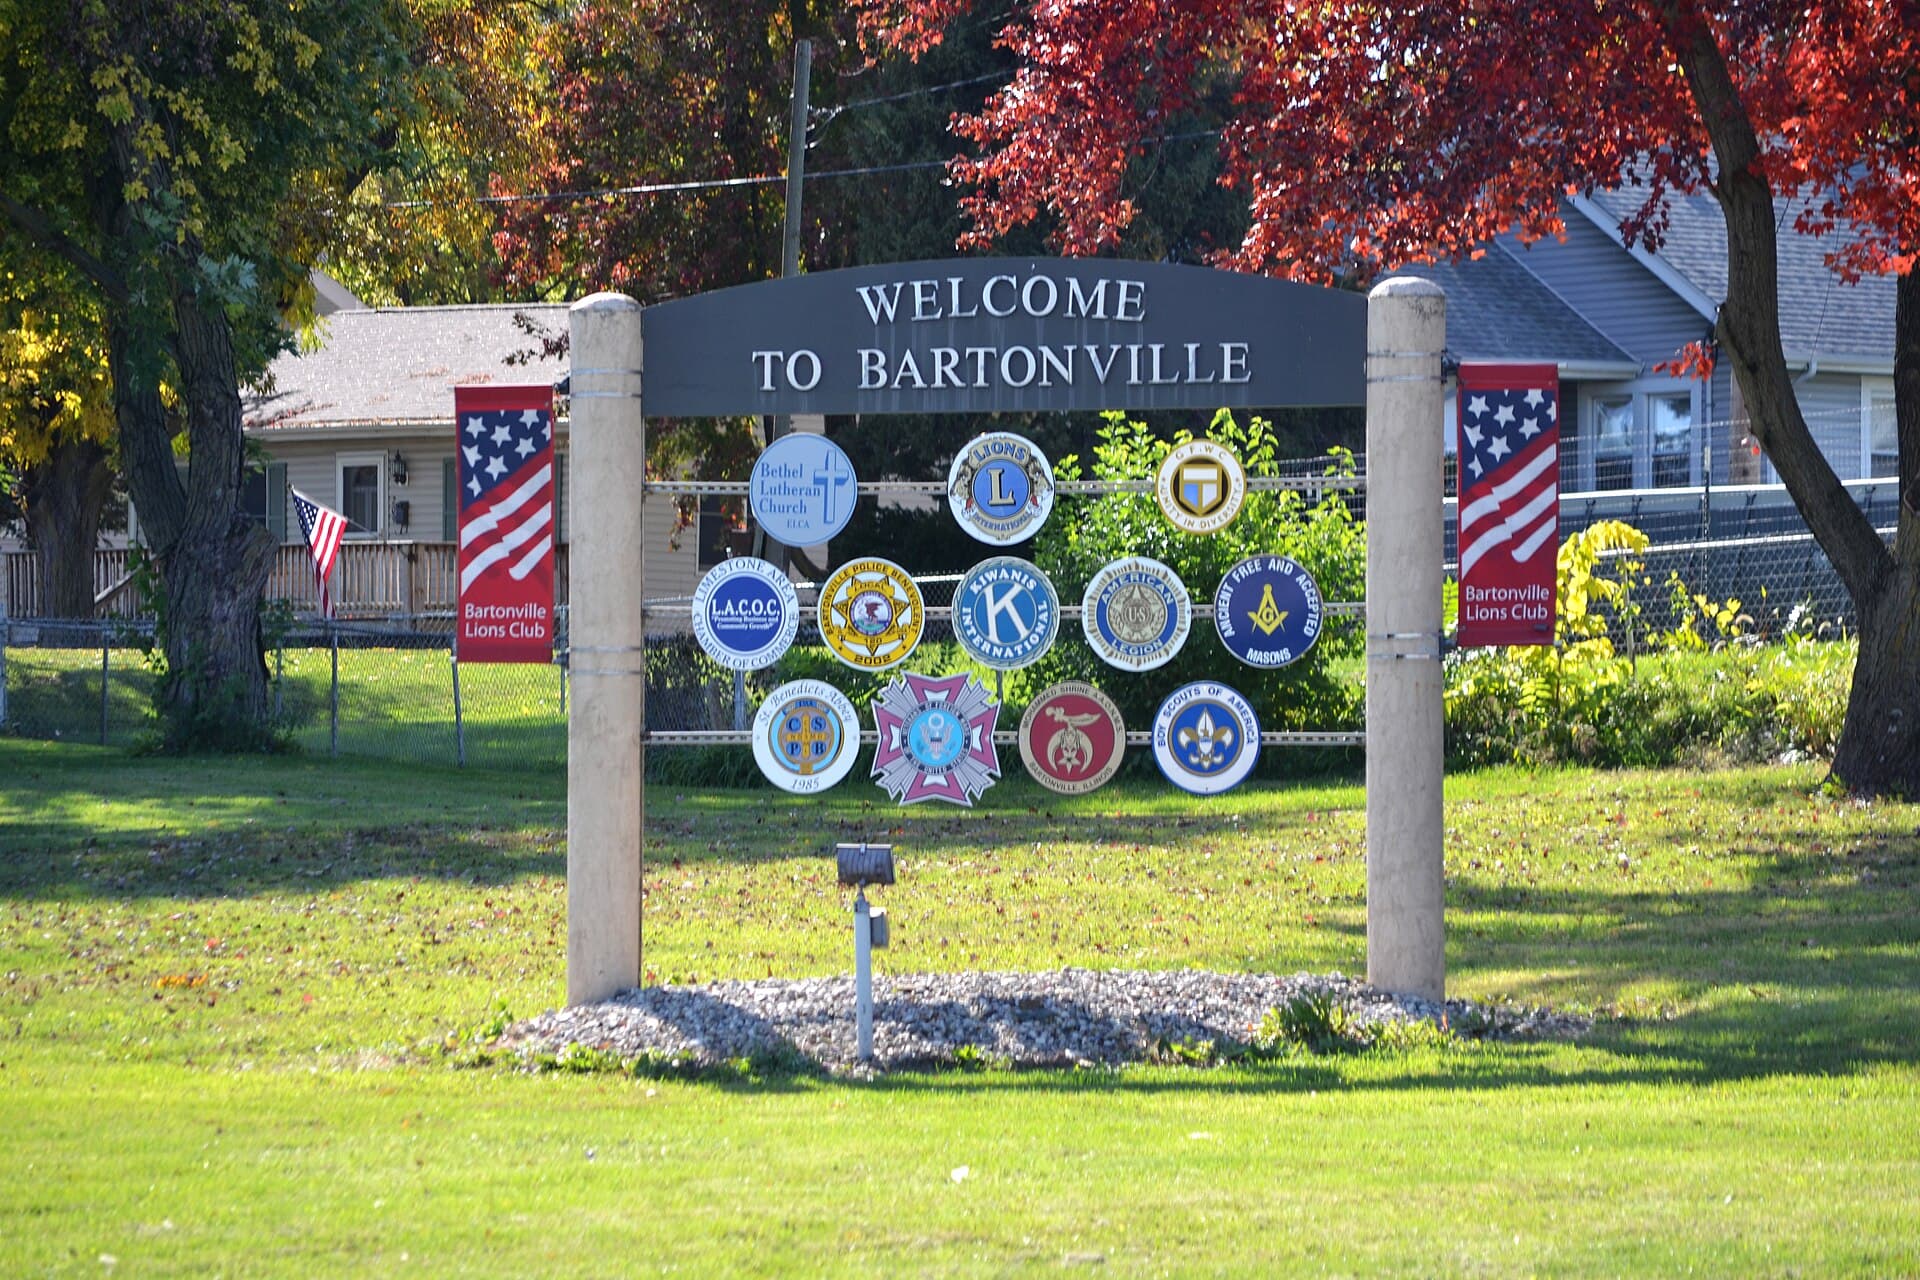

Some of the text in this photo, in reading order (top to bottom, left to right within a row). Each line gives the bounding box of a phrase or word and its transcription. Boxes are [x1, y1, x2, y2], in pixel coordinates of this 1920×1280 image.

[856, 275, 1146, 325] WELCOME
[752, 343, 1251, 391] TO BARTONVILLE
[973, 441, 1026, 461] LIONS
[760, 462, 803, 479] Bethel
[760, 481, 821, 497] Lutheran
[988, 468, 1016, 506] L
[760, 498, 807, 515] Church
[696, 558, 795, 604] LIMESTONE AREA
[969, 567, 1037, 595] KIWANIS
[1101, 573, 1175, 605] AMERICAN
[1466, 584, 1550, 601] Bartonville
[465, 602, 547, 619] Bartonville
[853, 562, 889, 573] POLICE
[891, 568, 921, 635] BENEVOLENT
[1218, 558, 1320, 638] ANCIENT FREE AND ACCEPTED
[1466, 603, 1548, 621] Lions Club
[962, 600, 1049, 658] INTERNATIONAL
[983, 583, 1032, 645] K
[465, 621, 545, 638] Lions Club
[693, 612, 799, 668] CHAMBER OF COMMERCE
[1112, 638, 1163, 655] LEGION
[1246, 647, 1292, 665] MASONS
[825, 690, 853, 722] Abbey
[1157, 686, 1255, 748] BOY SCOUTS OF AMERICA
[792, 778, 820, 791] 1985
